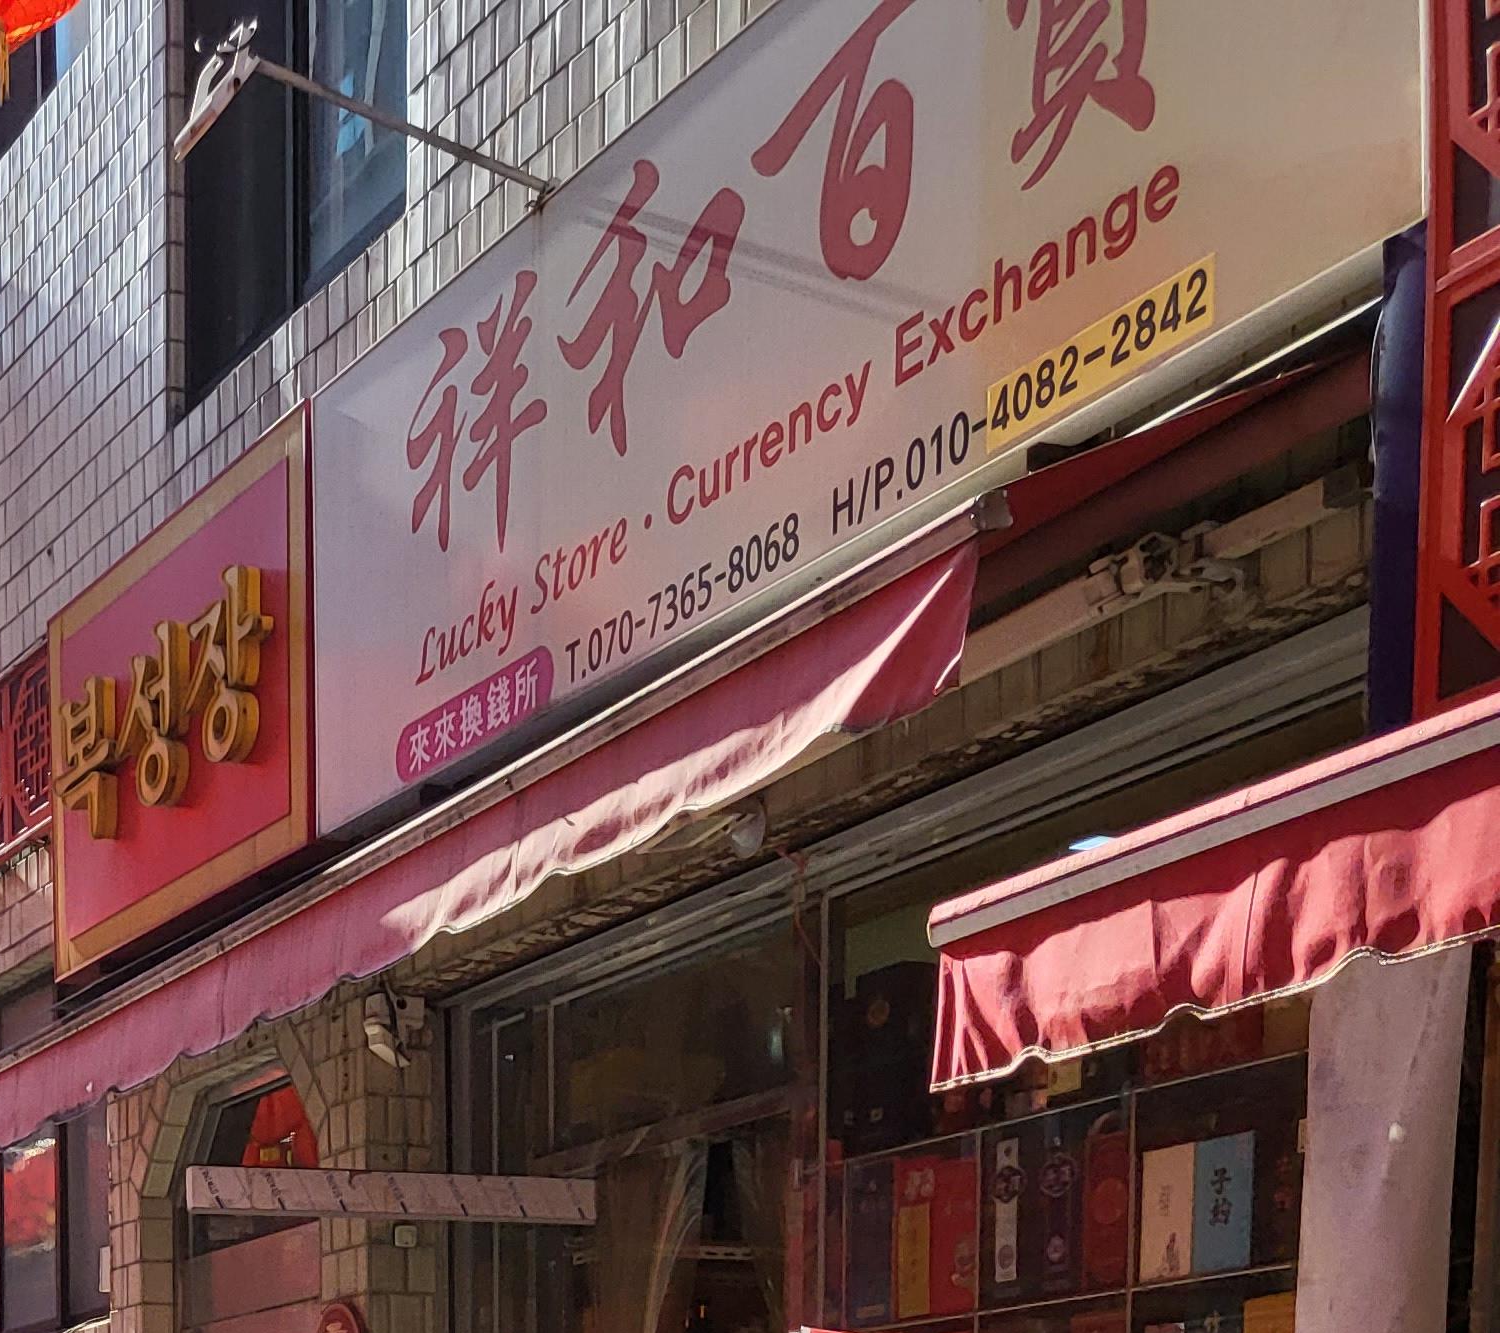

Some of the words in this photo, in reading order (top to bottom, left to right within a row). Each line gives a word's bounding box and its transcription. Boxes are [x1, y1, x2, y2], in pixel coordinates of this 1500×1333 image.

[414, 586, 518, 686] Lucky
[530, 519, 628, 616] Store
[665, 363, 872, 526] Currency
[895, 164, 1181, 387] Exchange
[565, 512, 801, 685] T.070-7365-8068
[831, 268, 1209, 536] H/P.010-4082-2842
[54, 564, 274, 840] 복성장
[408, 656, 542, 774] 來來換錢所
